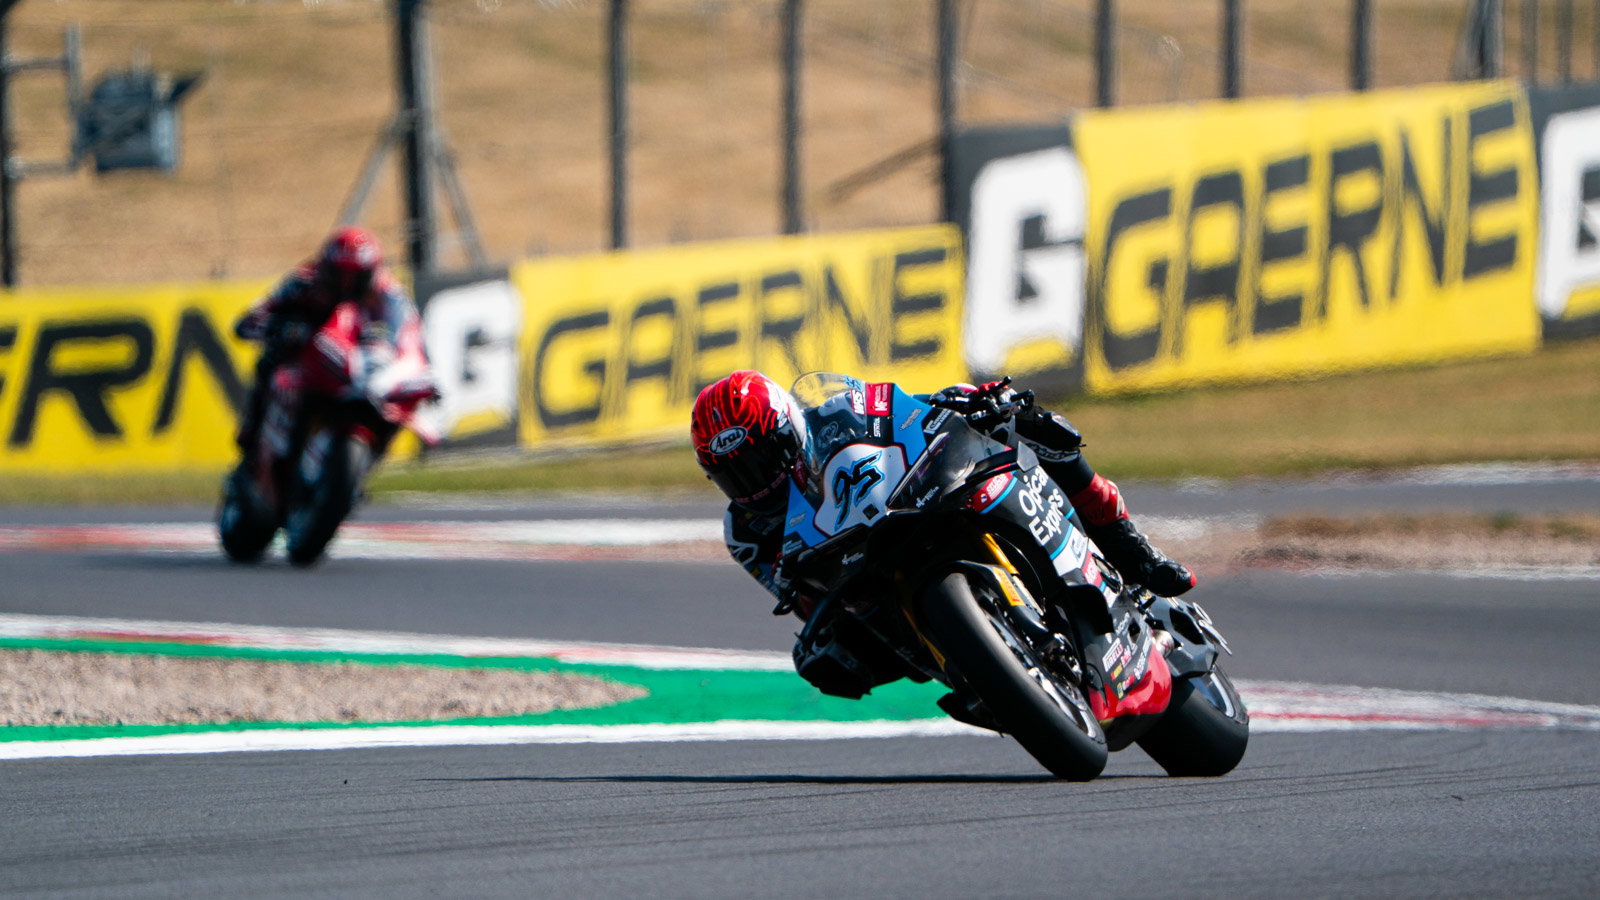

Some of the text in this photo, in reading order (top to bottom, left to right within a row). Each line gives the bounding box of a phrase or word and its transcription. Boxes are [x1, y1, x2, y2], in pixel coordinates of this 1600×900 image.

[1102, 99, 1519, 369] GAERNE
[534, 248, 947, 428] GAERNE
[713, 430, 741, 453] Arai
[832, 450, 885, 531] 95
